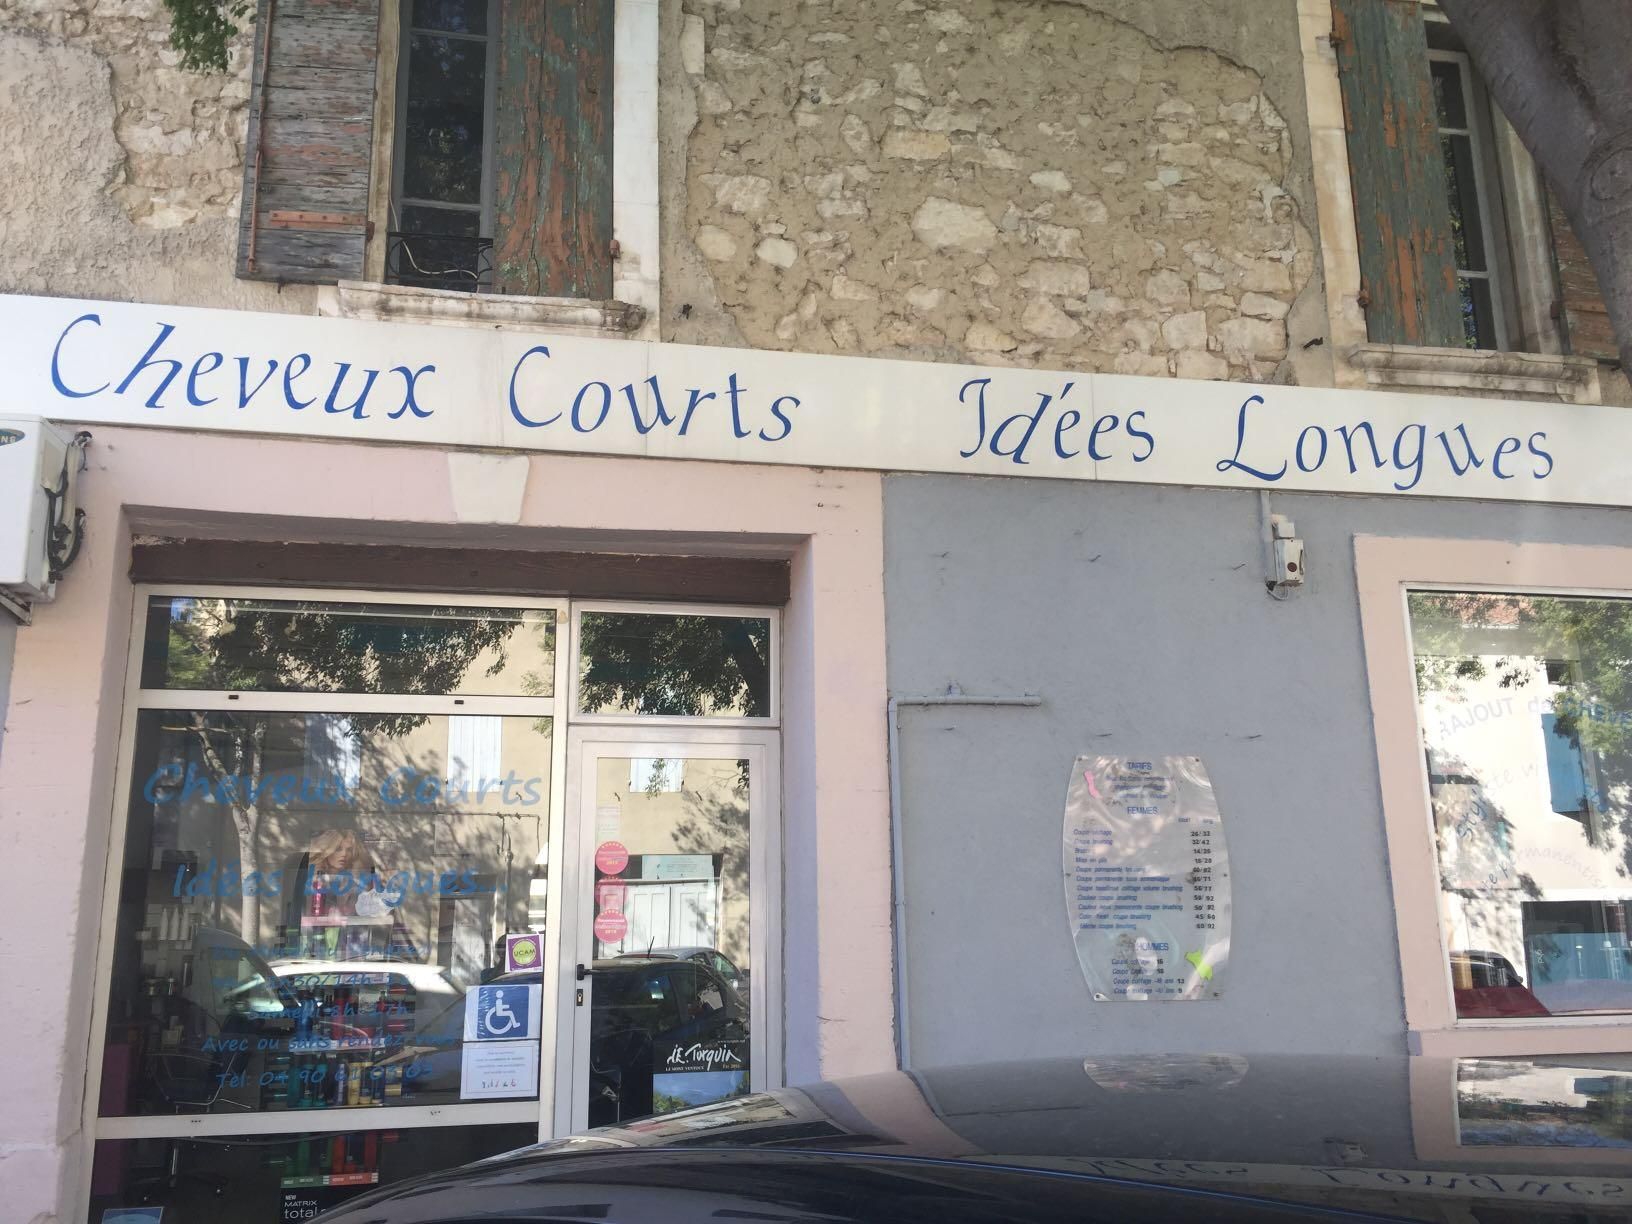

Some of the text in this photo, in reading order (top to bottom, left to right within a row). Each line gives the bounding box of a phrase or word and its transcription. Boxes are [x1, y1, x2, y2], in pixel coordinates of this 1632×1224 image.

[51, 314, 799, 442] Cheveux Courts
[959, 378, 1555, 491] Idées Longues
[144, 762, 542, 806] Cheveux Courts
[201, 1037, 249, 1053] Avec
[258, 1038, 280, 1051] ou
[300, 1069, 327, 1084] 90
[284, 1200, 318, 1208] MATRIX
[284, 1206, 318, 1220] total
